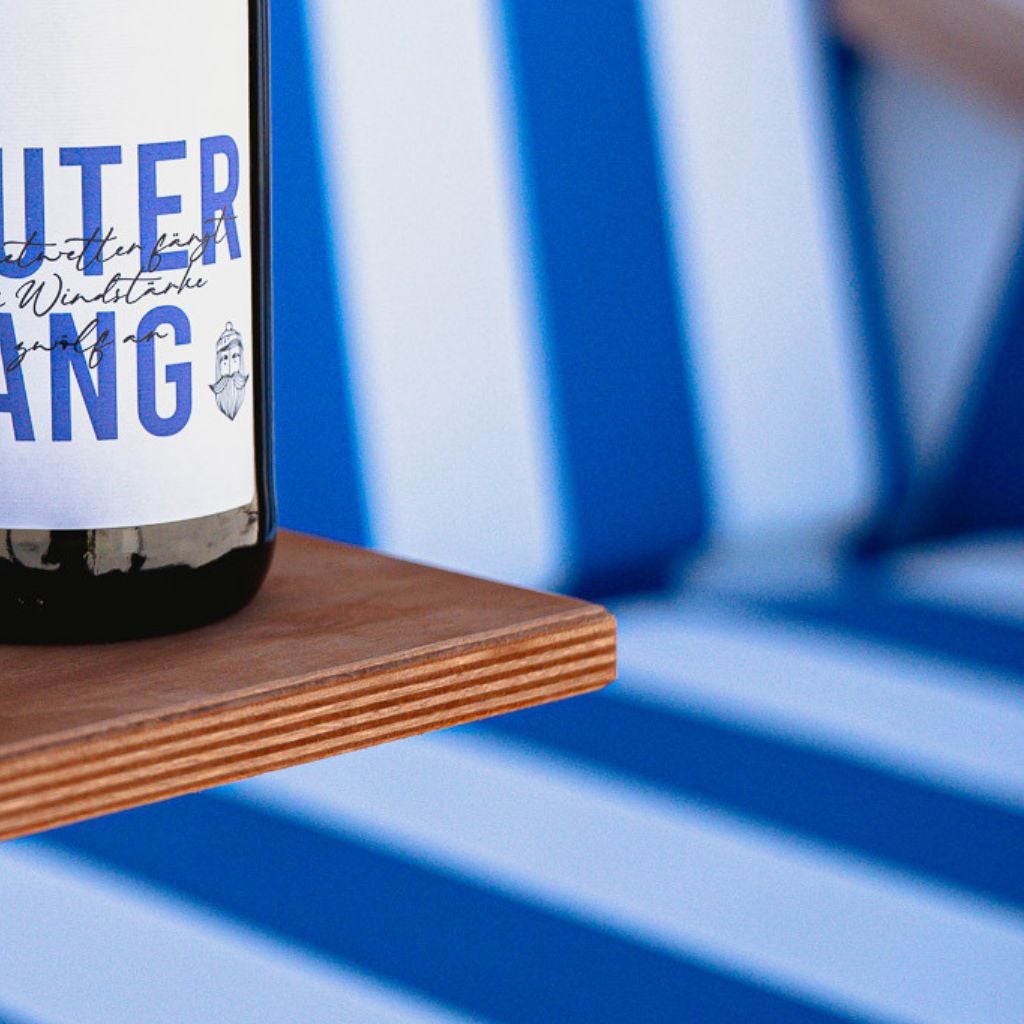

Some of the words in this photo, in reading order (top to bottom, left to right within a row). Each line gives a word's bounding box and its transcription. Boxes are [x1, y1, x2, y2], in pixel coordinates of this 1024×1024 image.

[147, 205, 239, 273] fängt
[15, 265, 208, 317] Windstärke
[5, 318, 115, 372] zwölf
[122, 329, 170, 346] an
